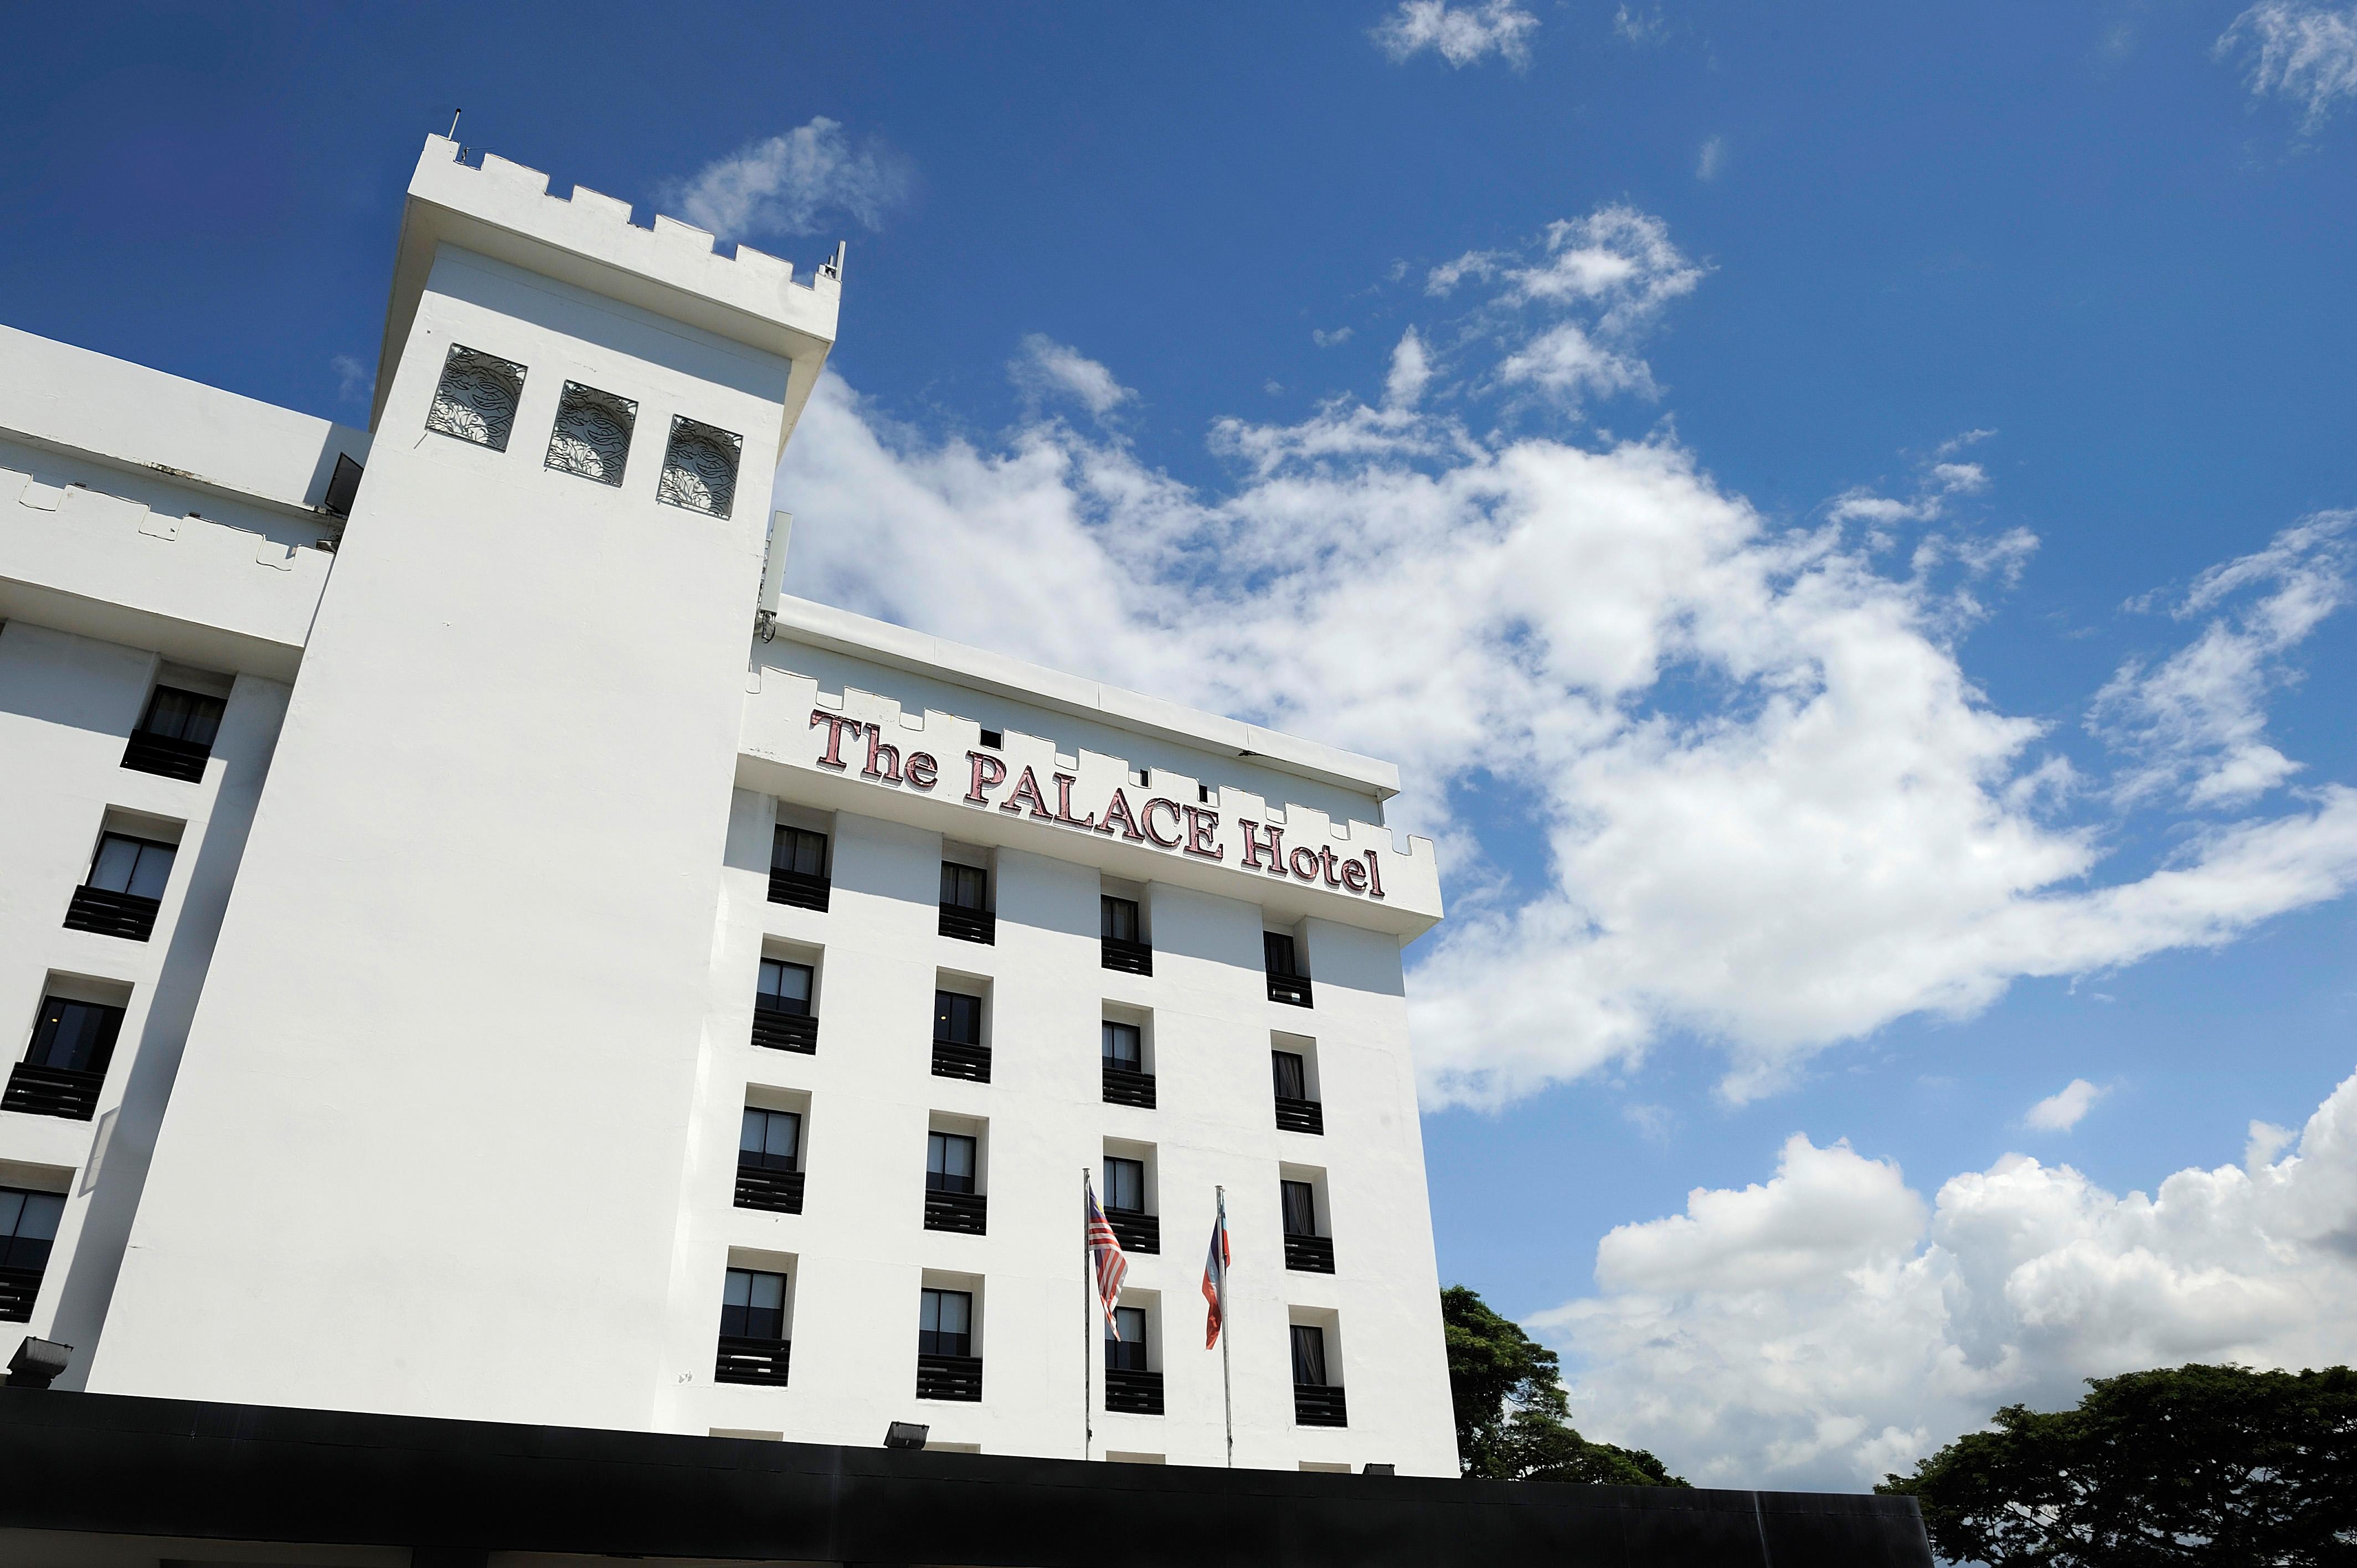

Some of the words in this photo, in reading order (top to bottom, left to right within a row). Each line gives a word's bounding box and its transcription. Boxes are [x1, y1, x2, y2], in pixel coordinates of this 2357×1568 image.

[811, 709, 938, 787] The
[965, 750, 1223, 859] PALACE
[1239, 818, 1385, 897] Hotel
